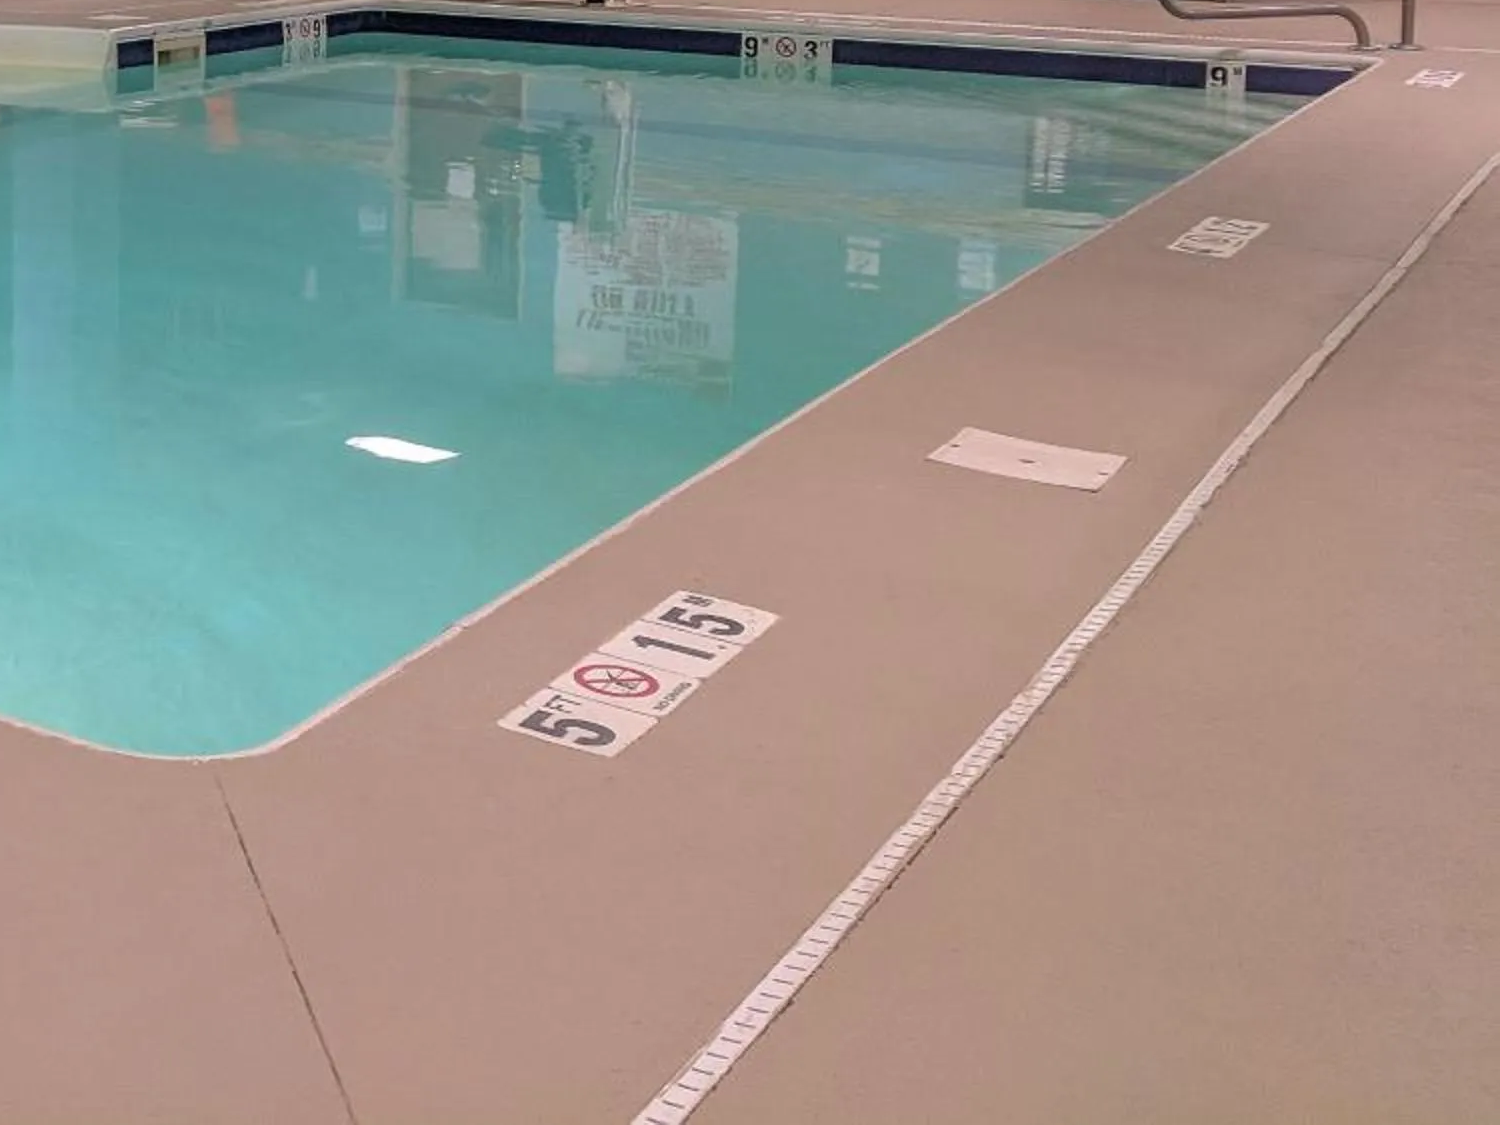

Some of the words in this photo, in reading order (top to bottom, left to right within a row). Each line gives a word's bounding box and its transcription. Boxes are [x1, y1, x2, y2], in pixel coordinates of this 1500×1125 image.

[744, 36, 758, 58] 9
[804, 40, 818, 59] 3
[1211, 66, 1228, 87] 9
